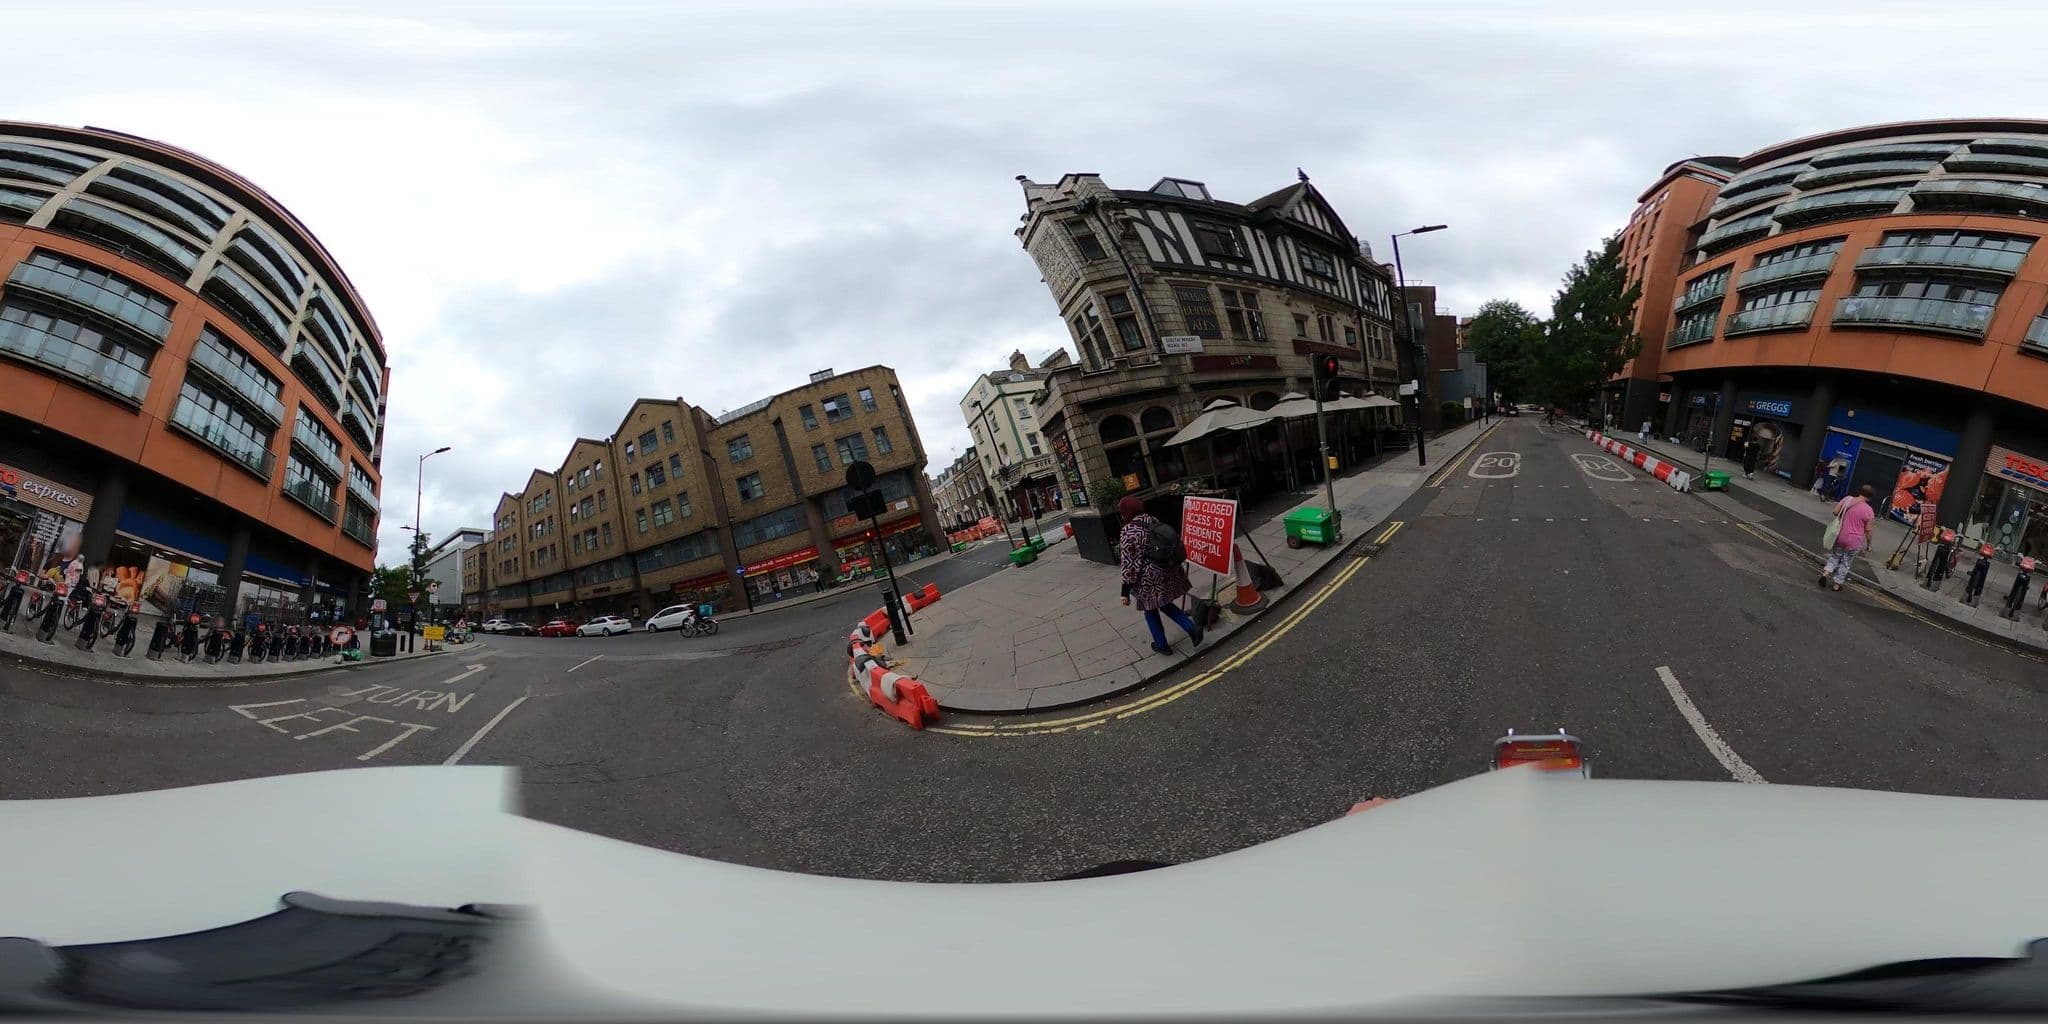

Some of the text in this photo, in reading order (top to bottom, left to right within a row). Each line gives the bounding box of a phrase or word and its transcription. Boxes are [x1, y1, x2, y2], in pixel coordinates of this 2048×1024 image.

[1756, 401, 1789, 413] GREGGS
[1479, 457, 1515, 468] 20
[23, 480, 79, 507] express
[1184, 499, 1233, 517] AD CLOSED
[1187, 512, 1225, 530] ACCESS TO
[1186, 523, 1222, 543] RESIDENTS
[1188, 537, 1222, 557] HOSPITAL
[1190, 550, 1208, 564] ONLY
[344, 684, 476, 713] TURN
[228, 698, 438, 761] LEFT
